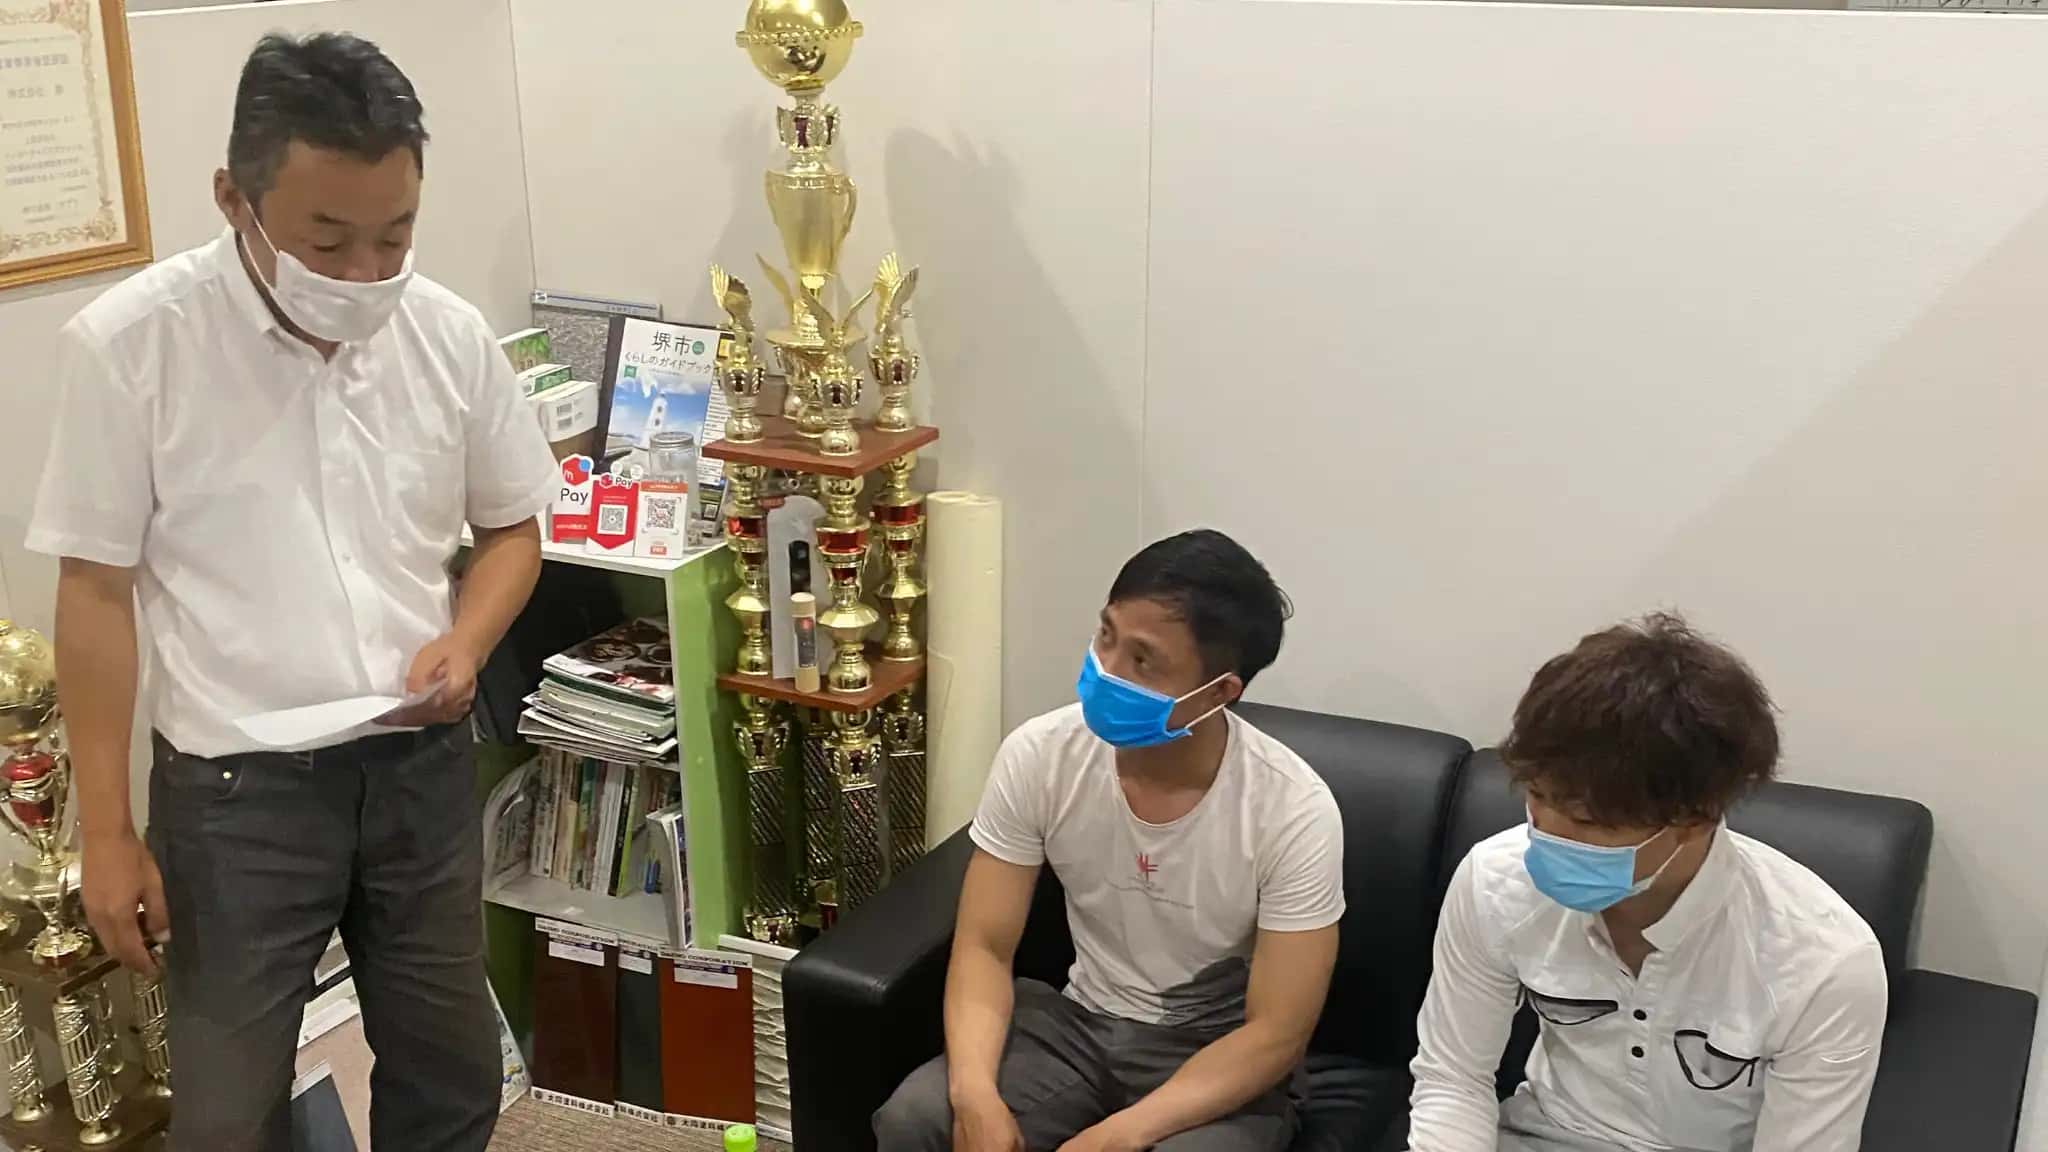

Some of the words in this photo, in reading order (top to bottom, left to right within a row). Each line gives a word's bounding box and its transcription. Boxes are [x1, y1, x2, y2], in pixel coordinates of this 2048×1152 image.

[651, 330, 692, 356] 堺市
[625, 352, 712, 374] くらしのガイドブック
[616, 477, 632, 489] Pay
[560, 487, 589, 505] Pay
